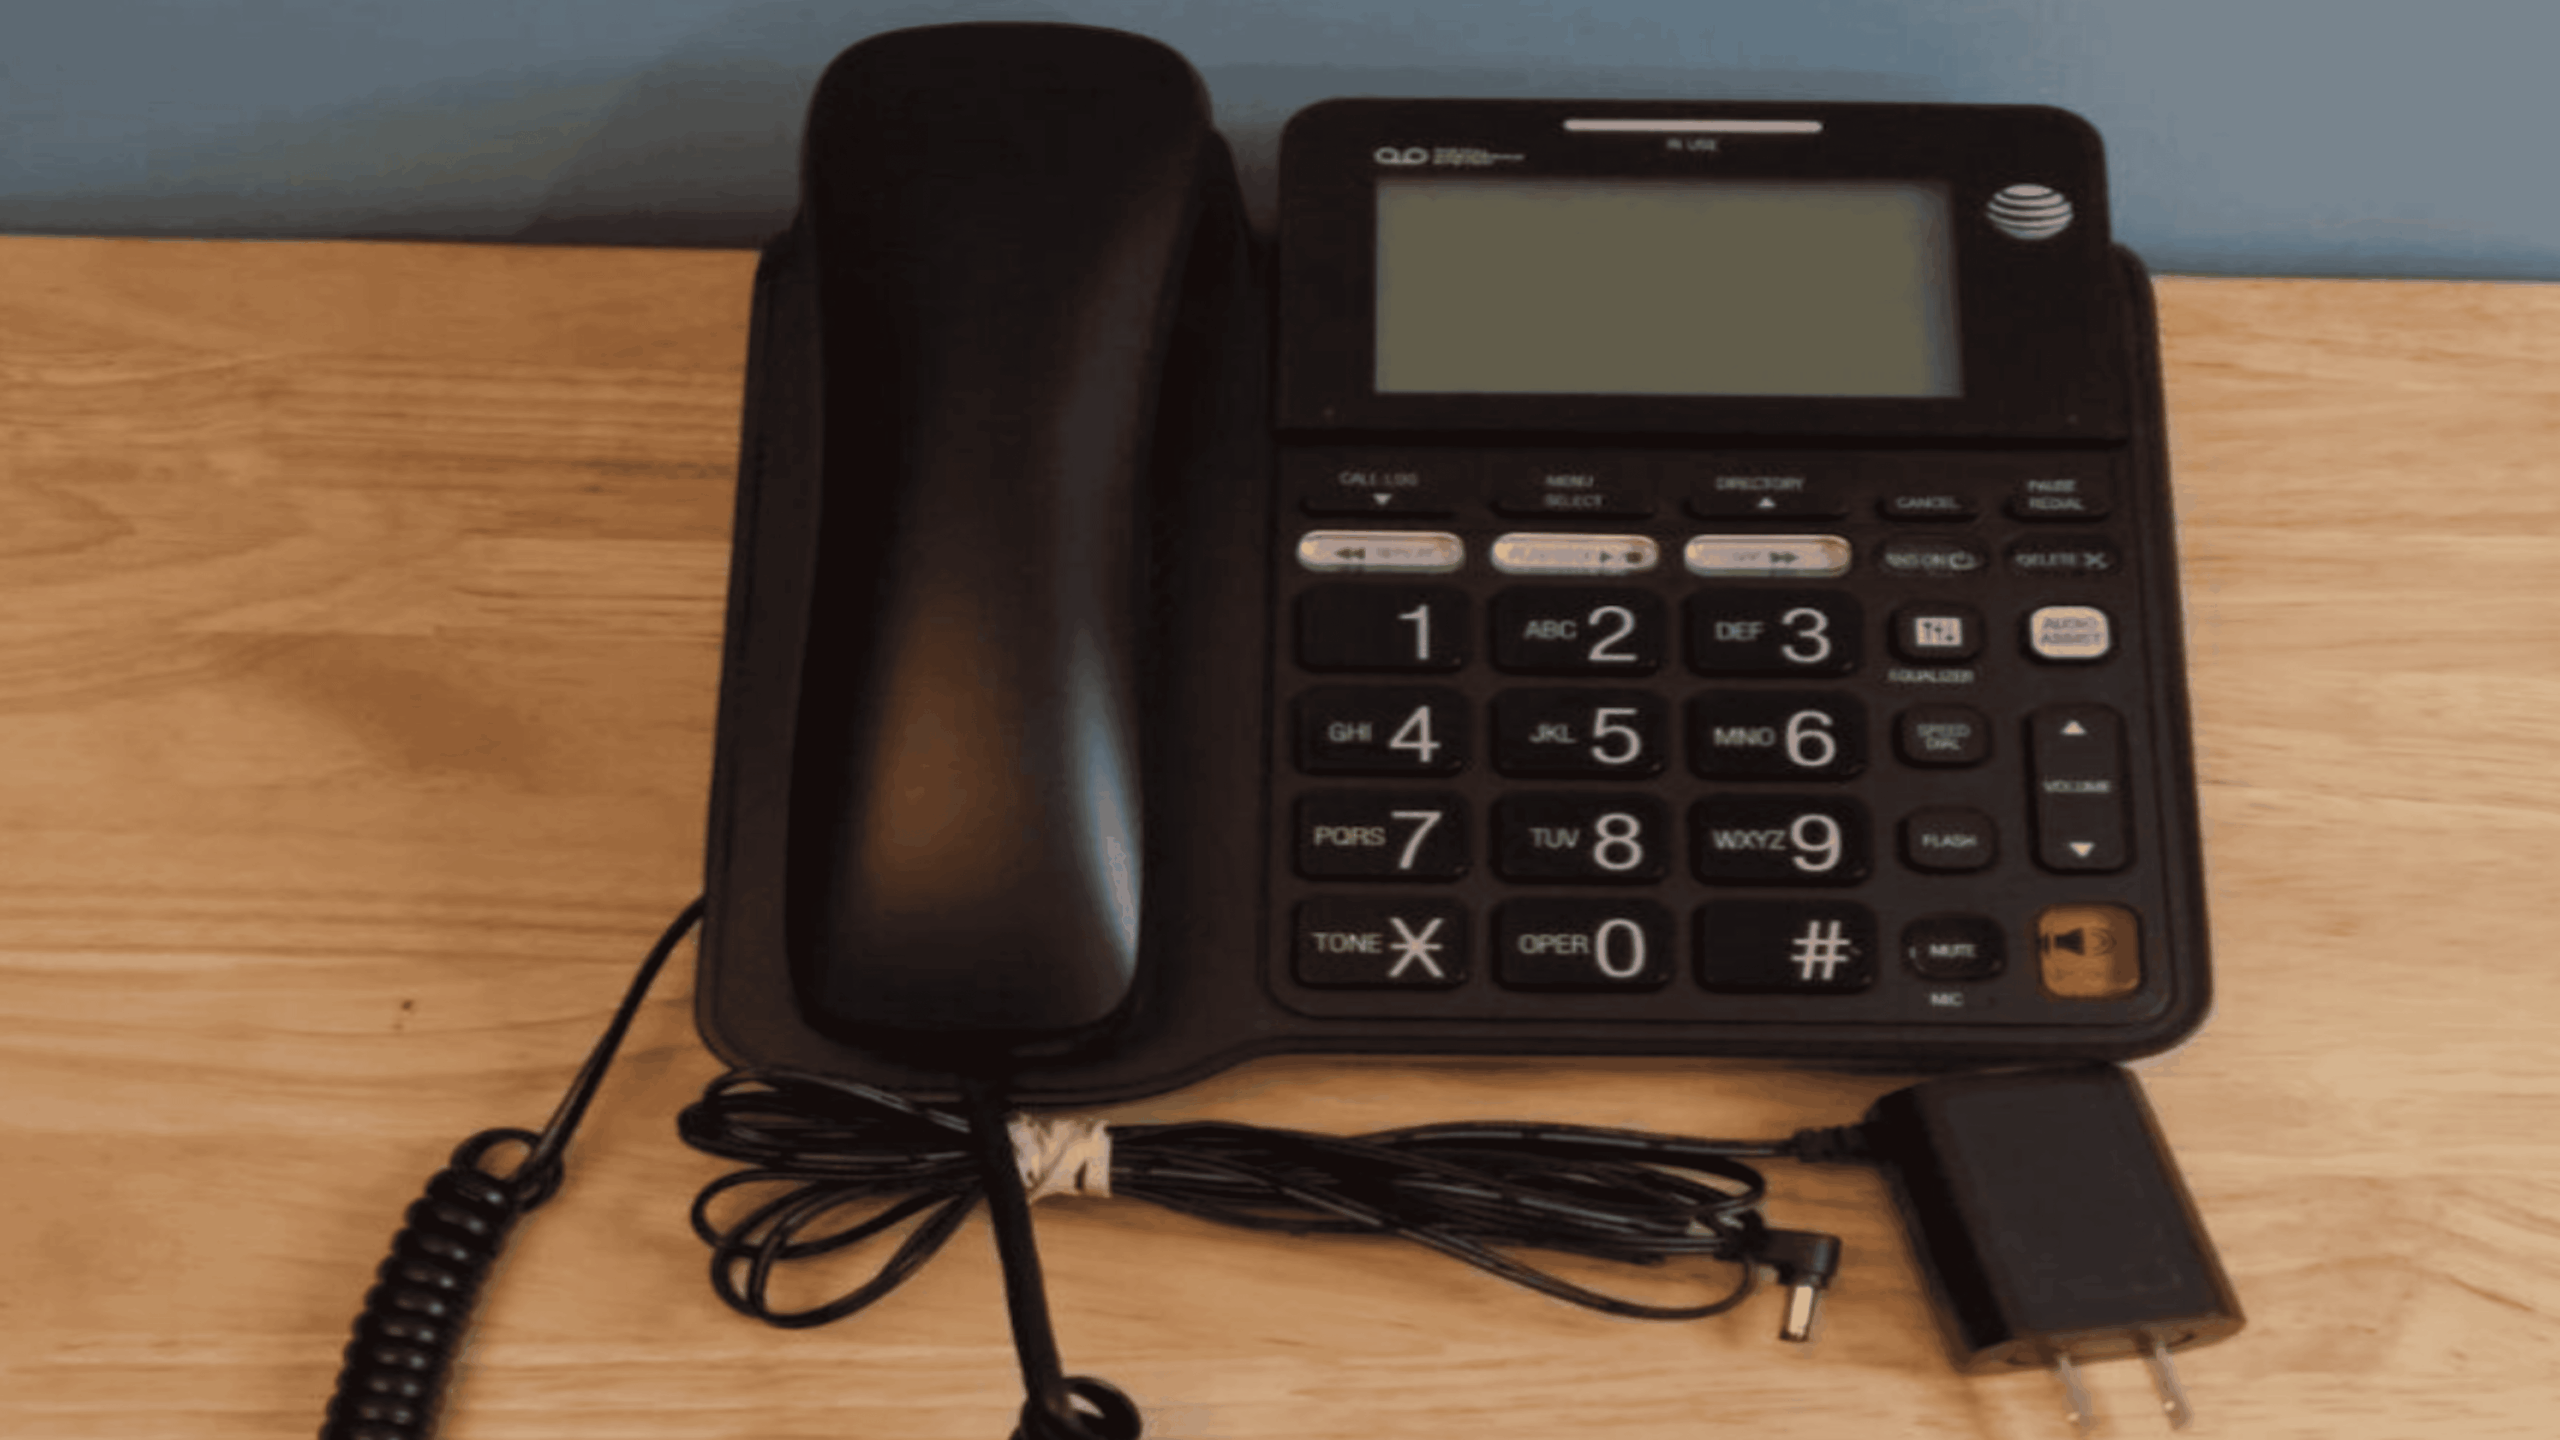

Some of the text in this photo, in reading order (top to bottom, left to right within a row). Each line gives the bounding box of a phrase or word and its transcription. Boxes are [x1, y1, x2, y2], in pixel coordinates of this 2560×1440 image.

[1339, 471, 1378, 486] CALL
[1545, 475, 1594, 488] MENU
[1716, 477, 1803, 490] DIRECTORY
[1544, 493, 1603, 509] SELECT
[1895, 496, 1959, 509] CANCEL
[2029, 496, 2084, 510] REDIAL
[1399, 605, 1429, 660] 1
[1524, 606, 1636, 661] ABC 2
[1715, 608, 1831, 663] DEF 3
[1888, 669, 1974, 684] EQUALIZER
[1328, 706, 1440, 762] GHI 4
[1530, 708, 1641, 764] JKL 5
[1713, 710, 1836, 767] MNO 6
[1917, 723, 1971, 737] SPEED
[2043, 780, 2110, 793] VOLUME
[1314, 811, 1441, 869] PQRS 7
[1530, 813, 1643, 870] TUV 8
[1713, 814, 1841, 872] WXYZ 9
[1922, 834, 1977, 848] FLASH
[1313, 932, 1381, 953] TONE
[1518, 918, 1645, 978] OPER 0
[1791, 921, 1850, 980] #
[1929, 944, 1974, 958] MUTE
[1930, 993, 1962, 1006] MIC
